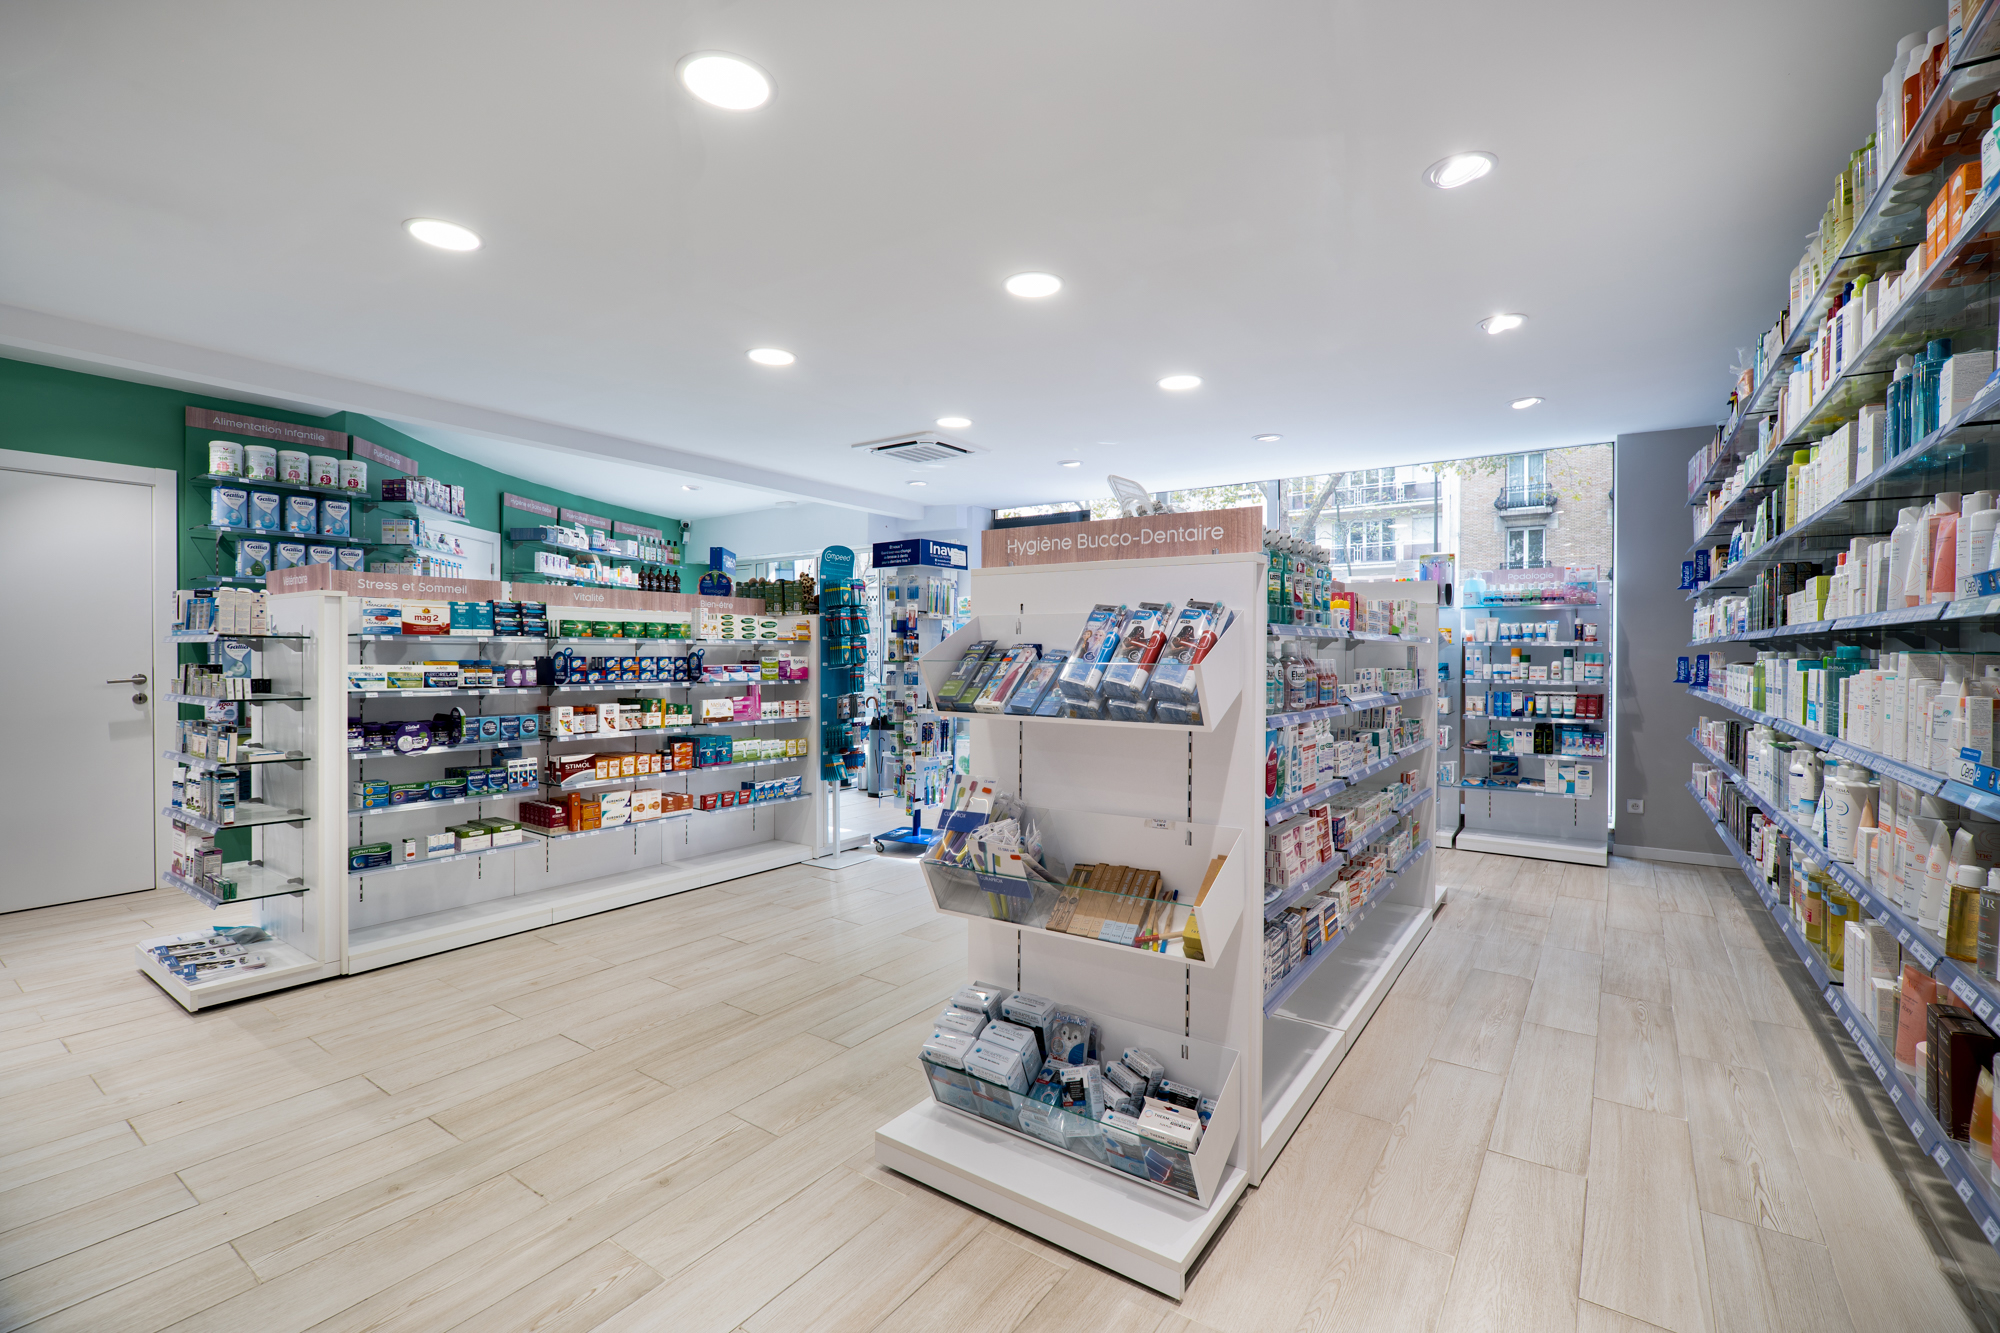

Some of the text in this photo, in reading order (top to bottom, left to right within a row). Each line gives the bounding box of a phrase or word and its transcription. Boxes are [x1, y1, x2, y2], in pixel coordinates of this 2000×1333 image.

[212, 416, 325, 442] Alimentation Infantile
[223, 490, 245, 499] Gallia
[256, 495, 277, 503] Gallia
[1007, 524, 1224, 556] Hygiène Bucco-Dentaire
[930, 542, 958, 556] Inav
[824, 550, 851, 562] Compeed
[1696, 554, 1706, 578] Hydralin
[282, 574, 308, 586] Vétérinaire
[1507, 571, 1554, 581] Podologie
[357, 578, 467, 594] Stress et Sommeil
[1964, 578, 1982, 594] CeraVe
[573, 592, 604, 602] Vitalité
[700, 600, 734, 610] Bien-être
[414, 614, 439, 624] mag 2
[1678, 660, 1686, 681] Hydralin
[1696, 660, 1706, 684] Hydralin
[565, 761, 592, 770] STIMOL
[1960, 762, 1981, 782] CeraVe
[352, 847, 381, 855] EUPHYTOSE
